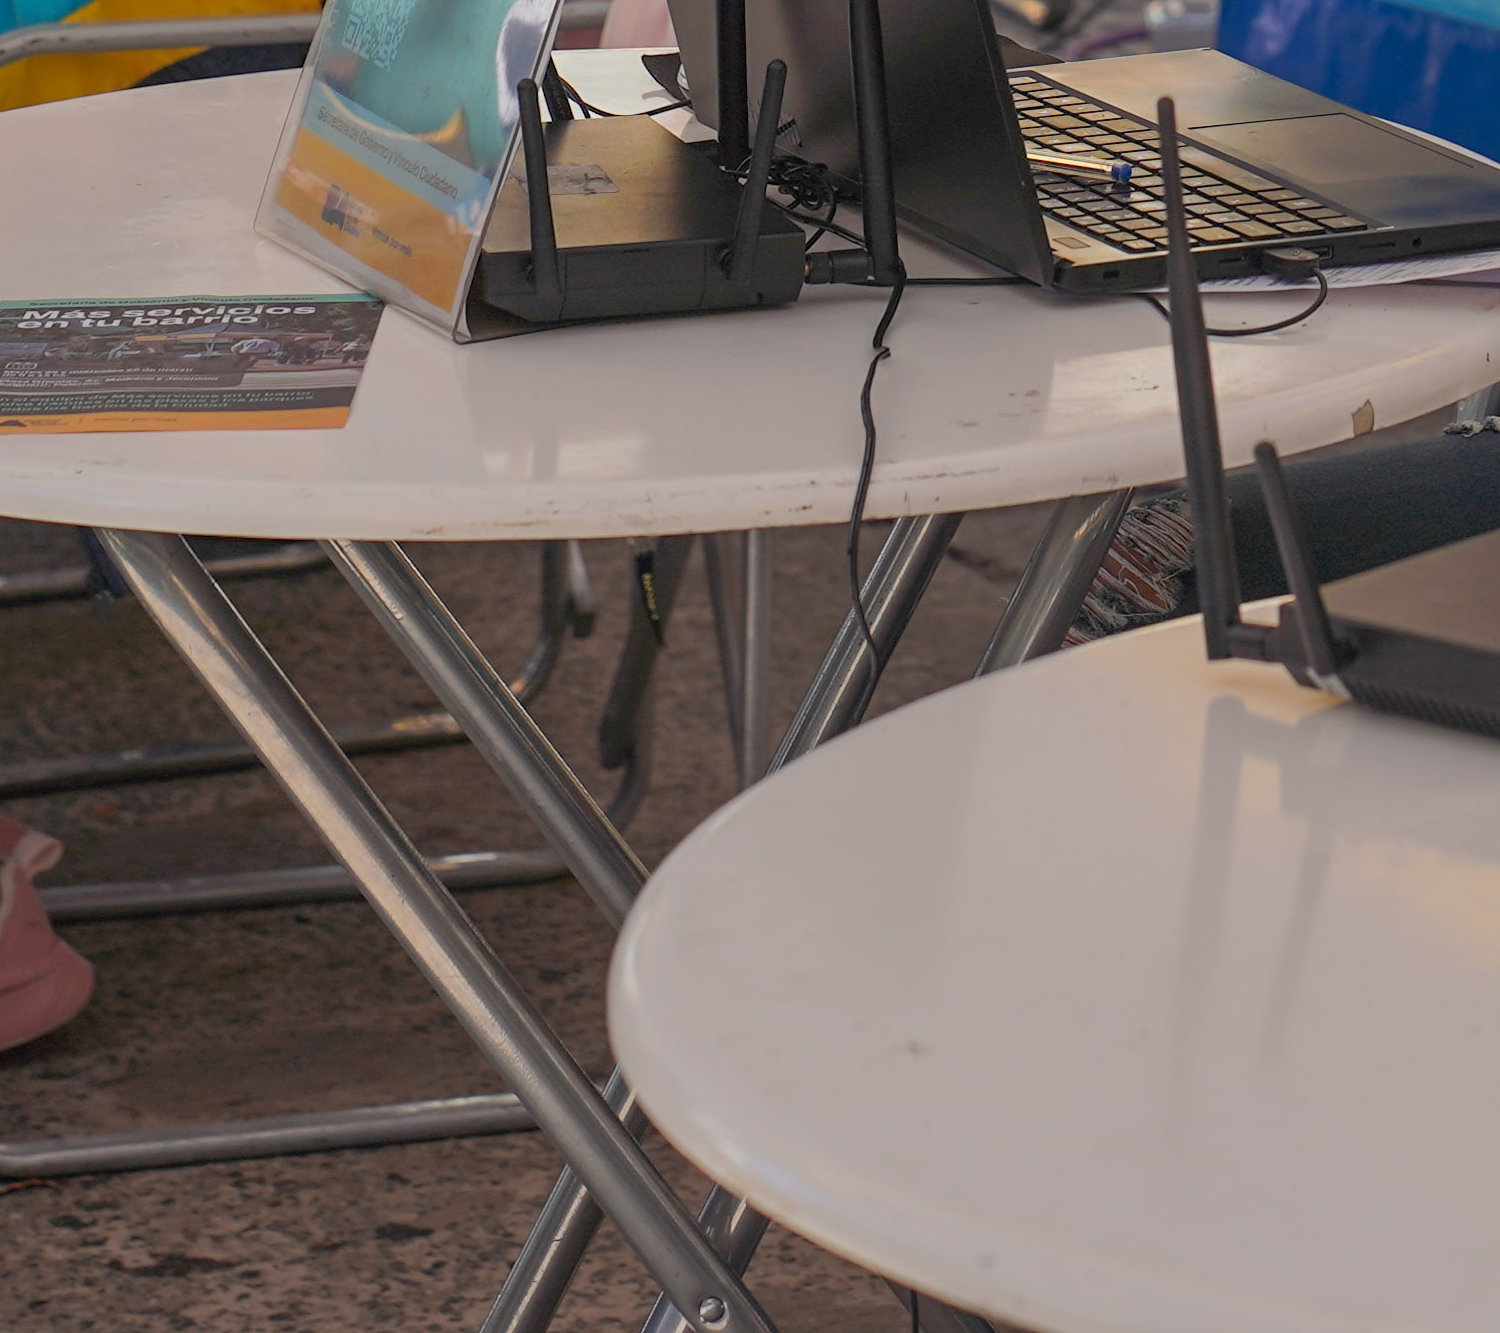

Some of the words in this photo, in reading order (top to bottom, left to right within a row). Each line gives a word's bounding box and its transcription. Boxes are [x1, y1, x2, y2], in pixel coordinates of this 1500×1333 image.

[22, 309, 111, 320] Más
[121, 304, 317, 318] servicios
[17, 319, 69, 329] en
[81, 318, 122, 328] tu
[132, 314, 260, 327] barrio
